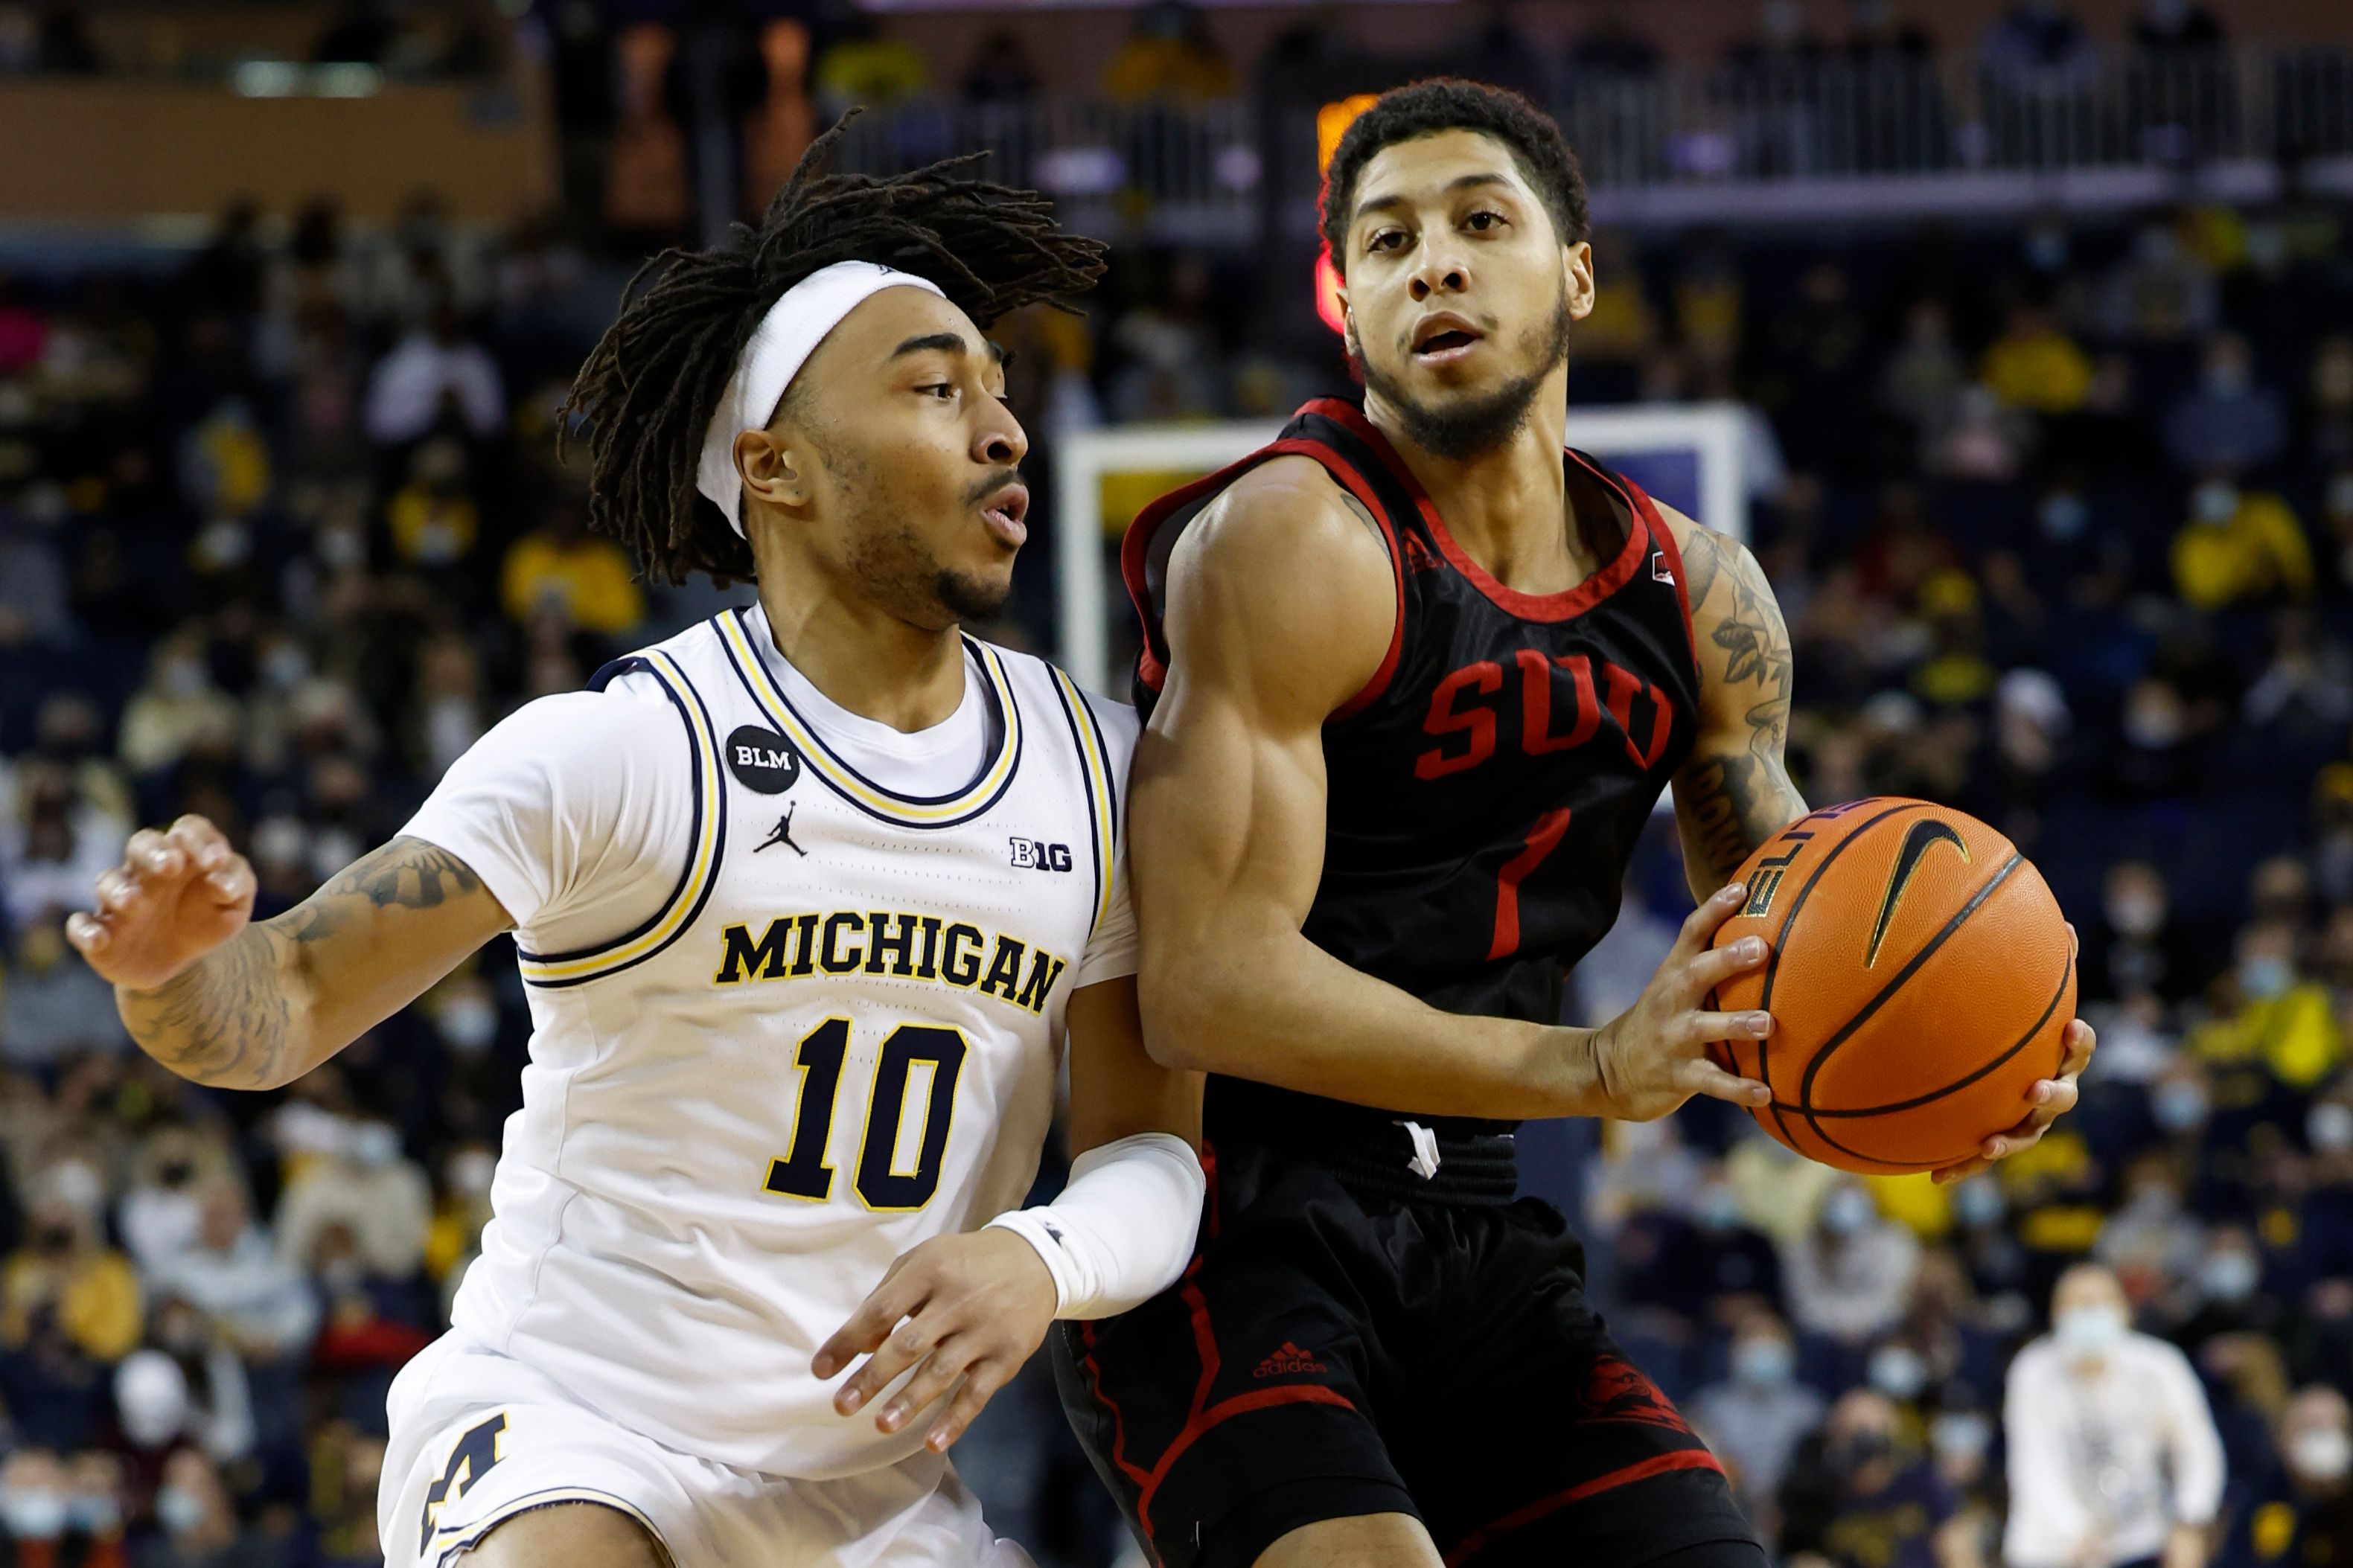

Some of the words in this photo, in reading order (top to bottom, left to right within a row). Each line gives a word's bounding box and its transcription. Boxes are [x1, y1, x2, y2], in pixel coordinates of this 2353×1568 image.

[735, 745, 792, 771] BLM
[1486, 807, 1571, 961] 1
[712, 912, 1067, 1015] MICHIGAN
[761, 1015, 970, 1212] 10
[1252, 1357, 1329, 1377] adidas
